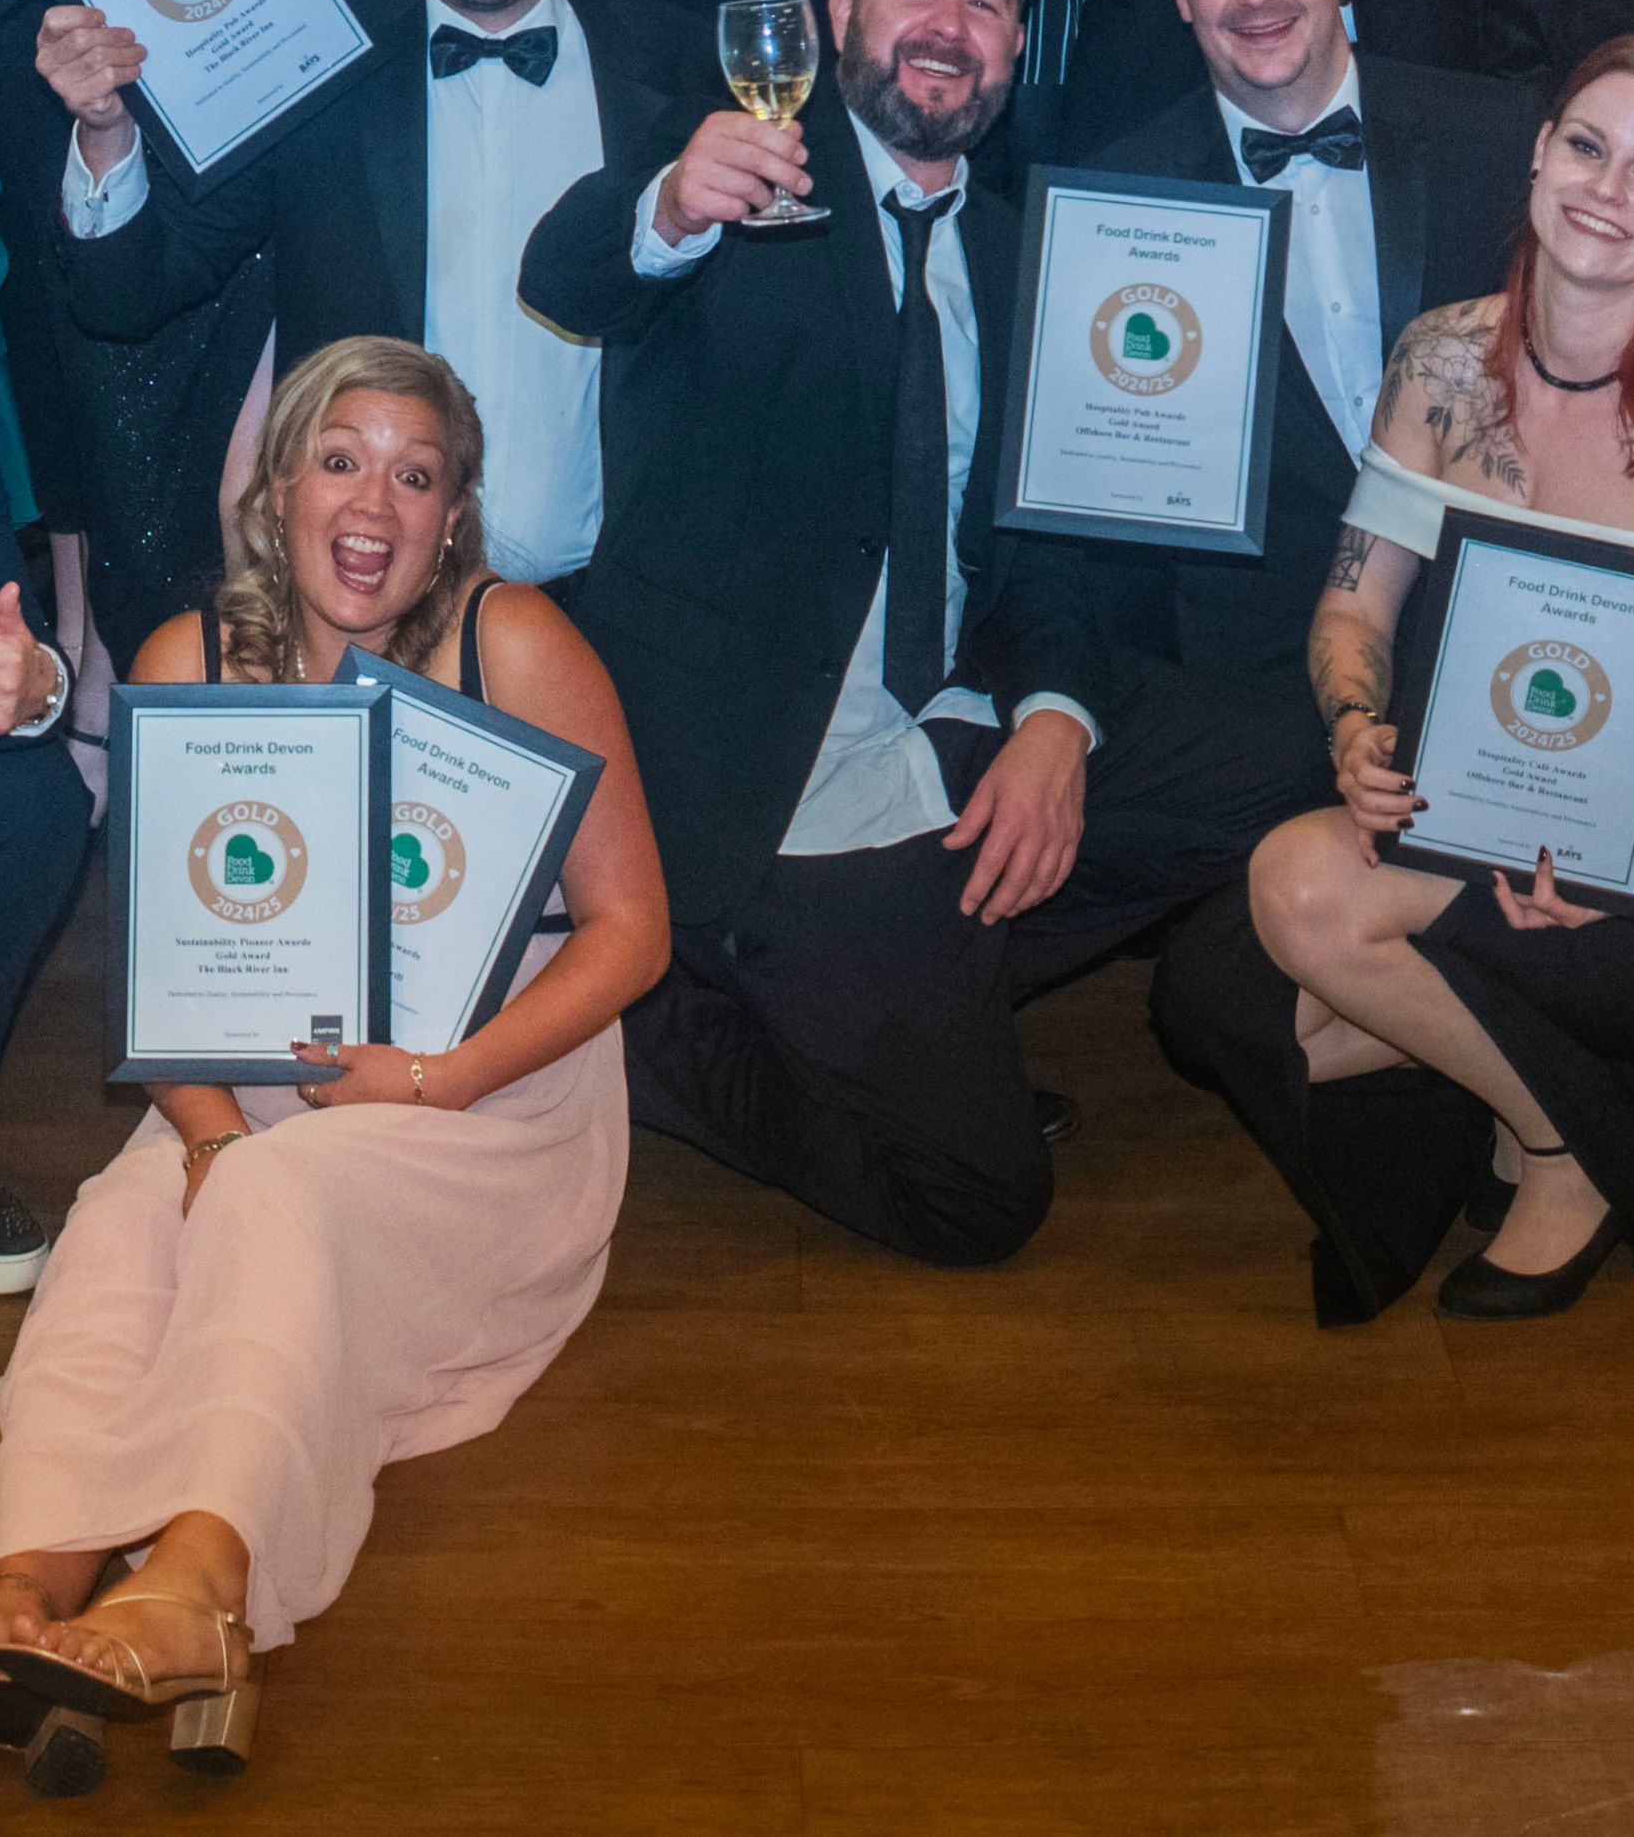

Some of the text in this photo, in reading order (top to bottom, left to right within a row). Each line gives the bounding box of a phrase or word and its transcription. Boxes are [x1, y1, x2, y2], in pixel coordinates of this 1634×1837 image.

[1096, 223, 1216, 248] Food Drink Devon
[1127, 246, 1180, 263] Awards
[1120, 287, 1179, 309] GOLD
[1107, 368, 1174, 393] 2024/25
[1508, 575, 1546, 594] Food
[1548, 584, 1588, 604] Drink
[1540, 601, 1597, 624] Awards
[1527, 642, 1590, 670] GOLD
[1506, 719, 1577, 748] 2024/25
[185, 741, 312, 754] Food Drink Devon
[393, 727, 511, 791] Food Drink Devon
[220, 762, 275, 774] Awards
[417, 761, 470, 794] Awards
[216, 804, 279, 827] GOLD
[394, 804, 453, 841] GOLD
[210, 897, 281, 920] 2024/25
[175, 937, 311, 947] Sustainability Pioneer Awards
[215, 950, 270, 959] Gold Award
[197, 964, 288, 973] The Black River Inn
